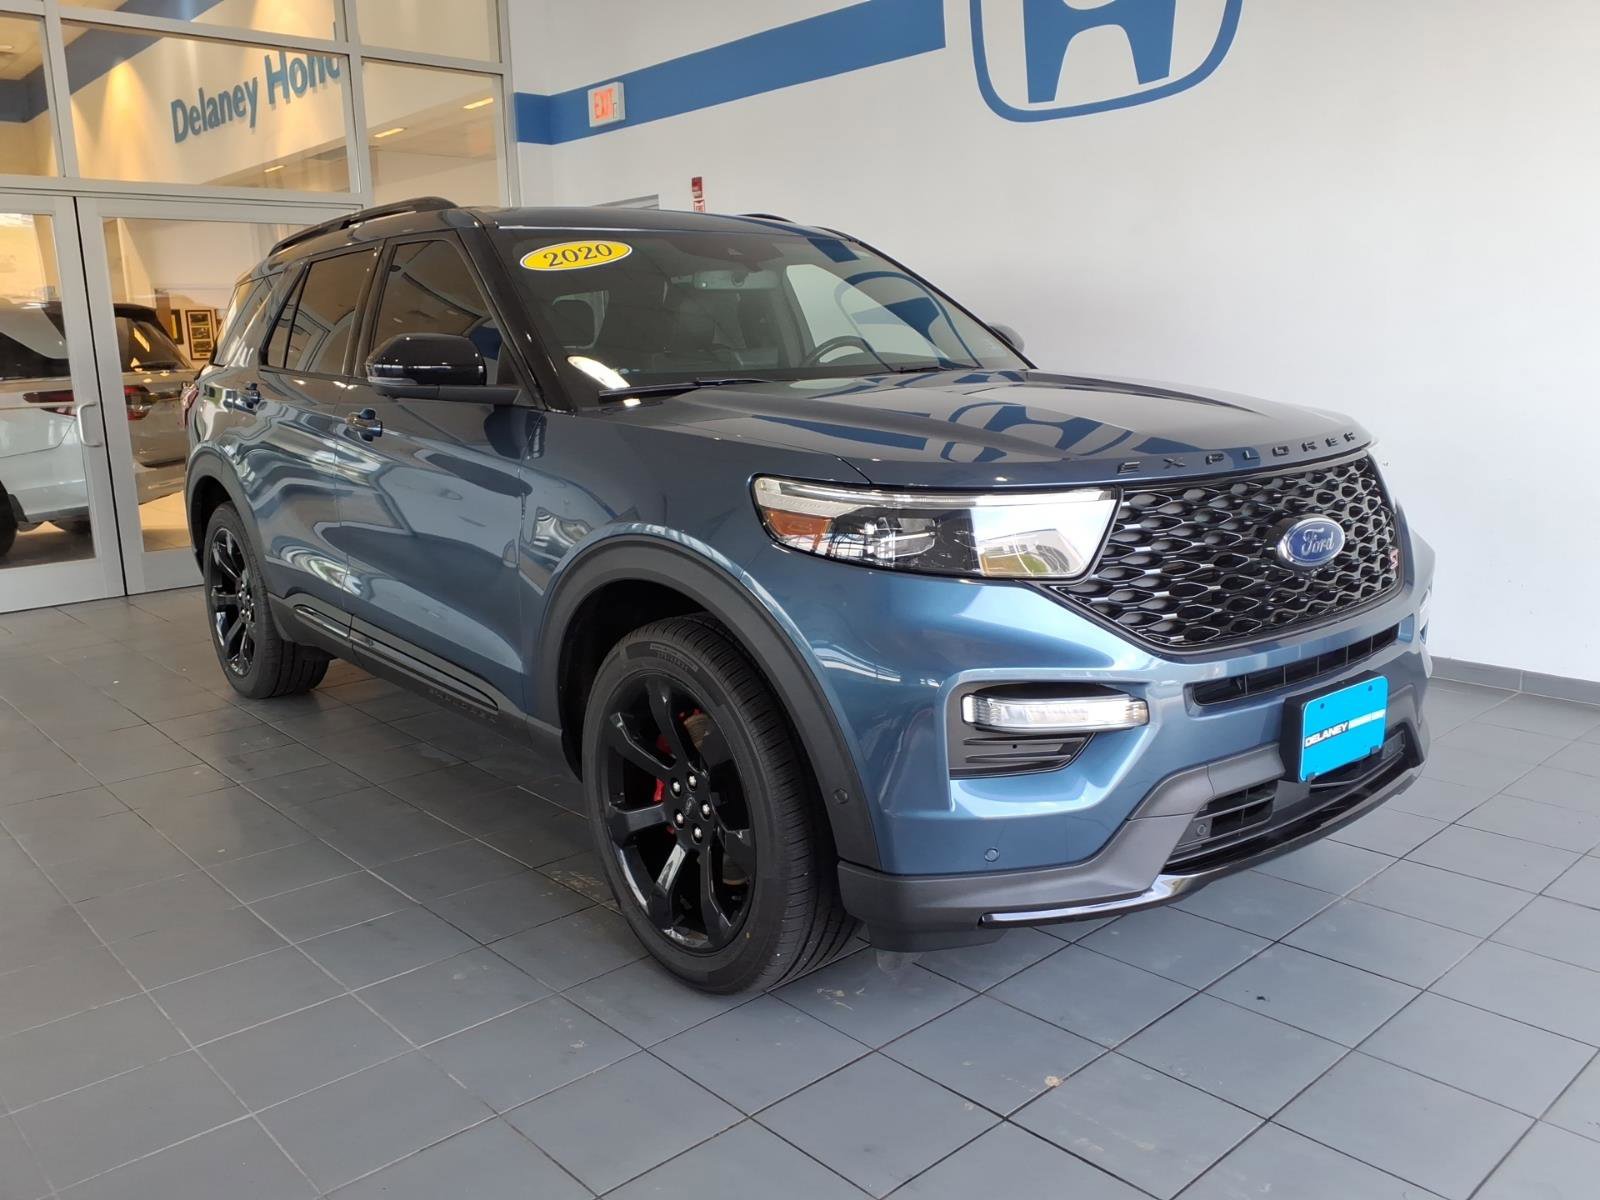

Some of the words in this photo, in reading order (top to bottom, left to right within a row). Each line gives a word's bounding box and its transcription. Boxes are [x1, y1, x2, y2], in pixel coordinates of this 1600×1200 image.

[170, 76, 258, 143] Delaney
[543, 243, 613, 267] 2020
[1117, 431, 1355, 476] EXPLORER
[1301, 527, 1335, 555] Ford
[1305, 722, 1349, 748] DELANEY
